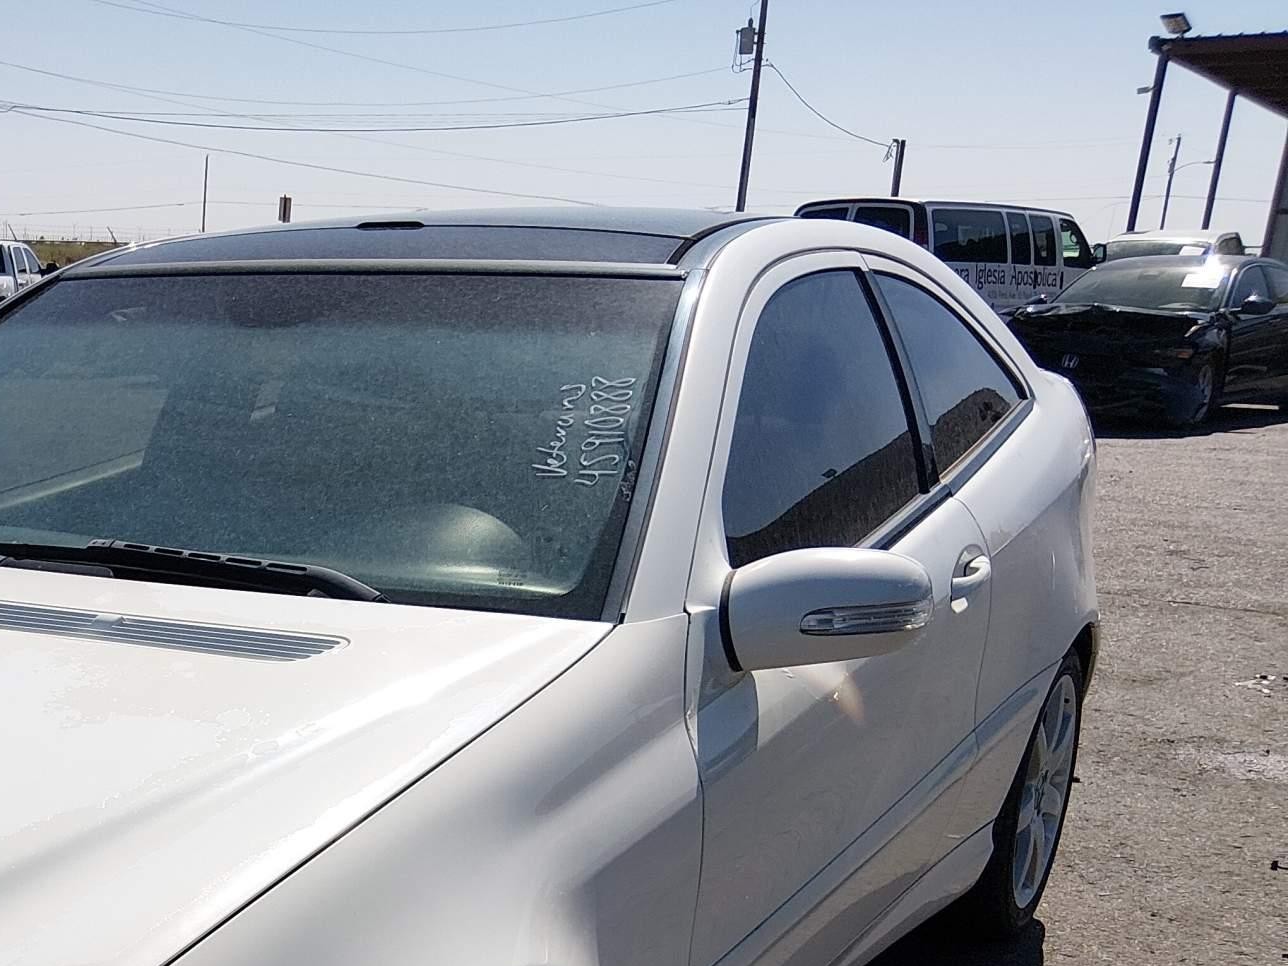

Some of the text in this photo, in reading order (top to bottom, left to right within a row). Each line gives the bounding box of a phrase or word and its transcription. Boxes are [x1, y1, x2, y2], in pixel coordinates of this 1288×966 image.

[975, 264, 1006, 290] Iglesia
[1010, 264, 1057, 291] Aposolica
[574, 376, 637, 486] 45910888
